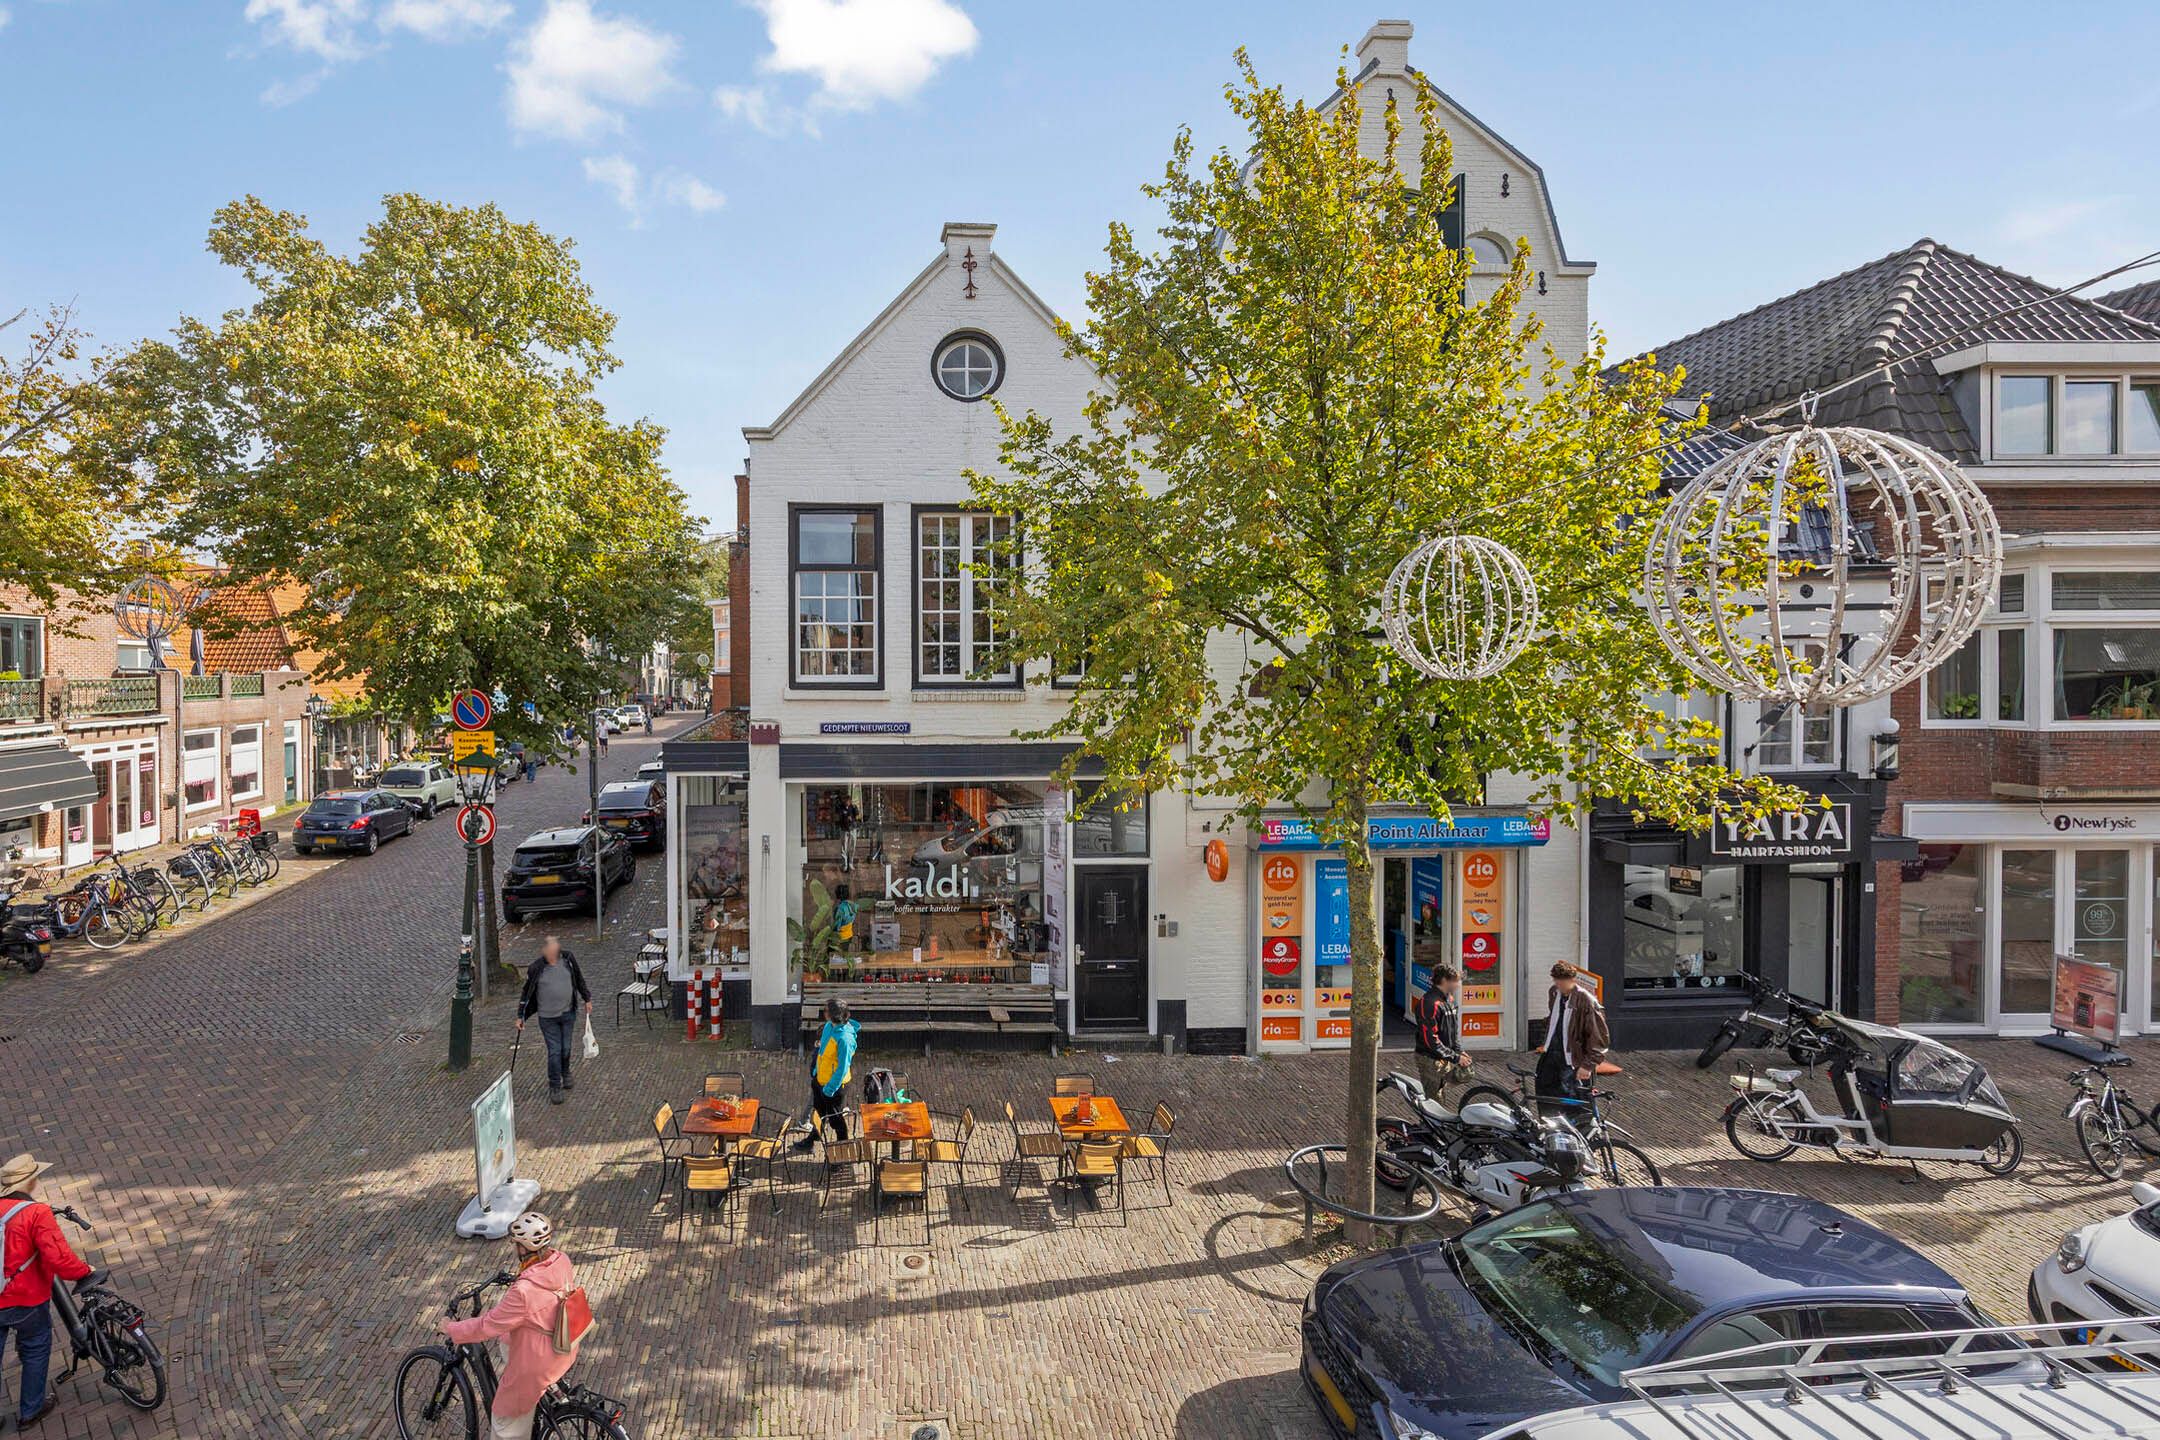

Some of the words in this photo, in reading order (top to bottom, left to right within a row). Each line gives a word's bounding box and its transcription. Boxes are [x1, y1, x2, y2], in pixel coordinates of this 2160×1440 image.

[824, 724, 858, 732] GEDEMPTE
[860, 724, 908, 732] NIEUWESLOOT
[1268, 824, 1312, 835] LEBARA
[1503, 821, 1546, 832] LEBARA
[1718, 811, 1844, 842] YARA
[2072, 816, 2136, 831] NewFysic
[1370, 824, 1414, 839] Point
[1417, 824, 1488, 838] Alkmaar
[1208, 845, 1220, 868] ria
[1730, 846, 1832, 857] HAIRFASHION
[1268, 861, 1294, 878] ria
[1468, 858, 1494, 876] ria
[885, 860, 969, 898] kaldi
[894, 904, 914, 914] koffie
[930, 904, 960, 912] karakter
[1263, 1022, 1281, 1034] ria
[1325, 1023, 1343, 1035] ria
[1464, 1019, 1480, 1030] ria
